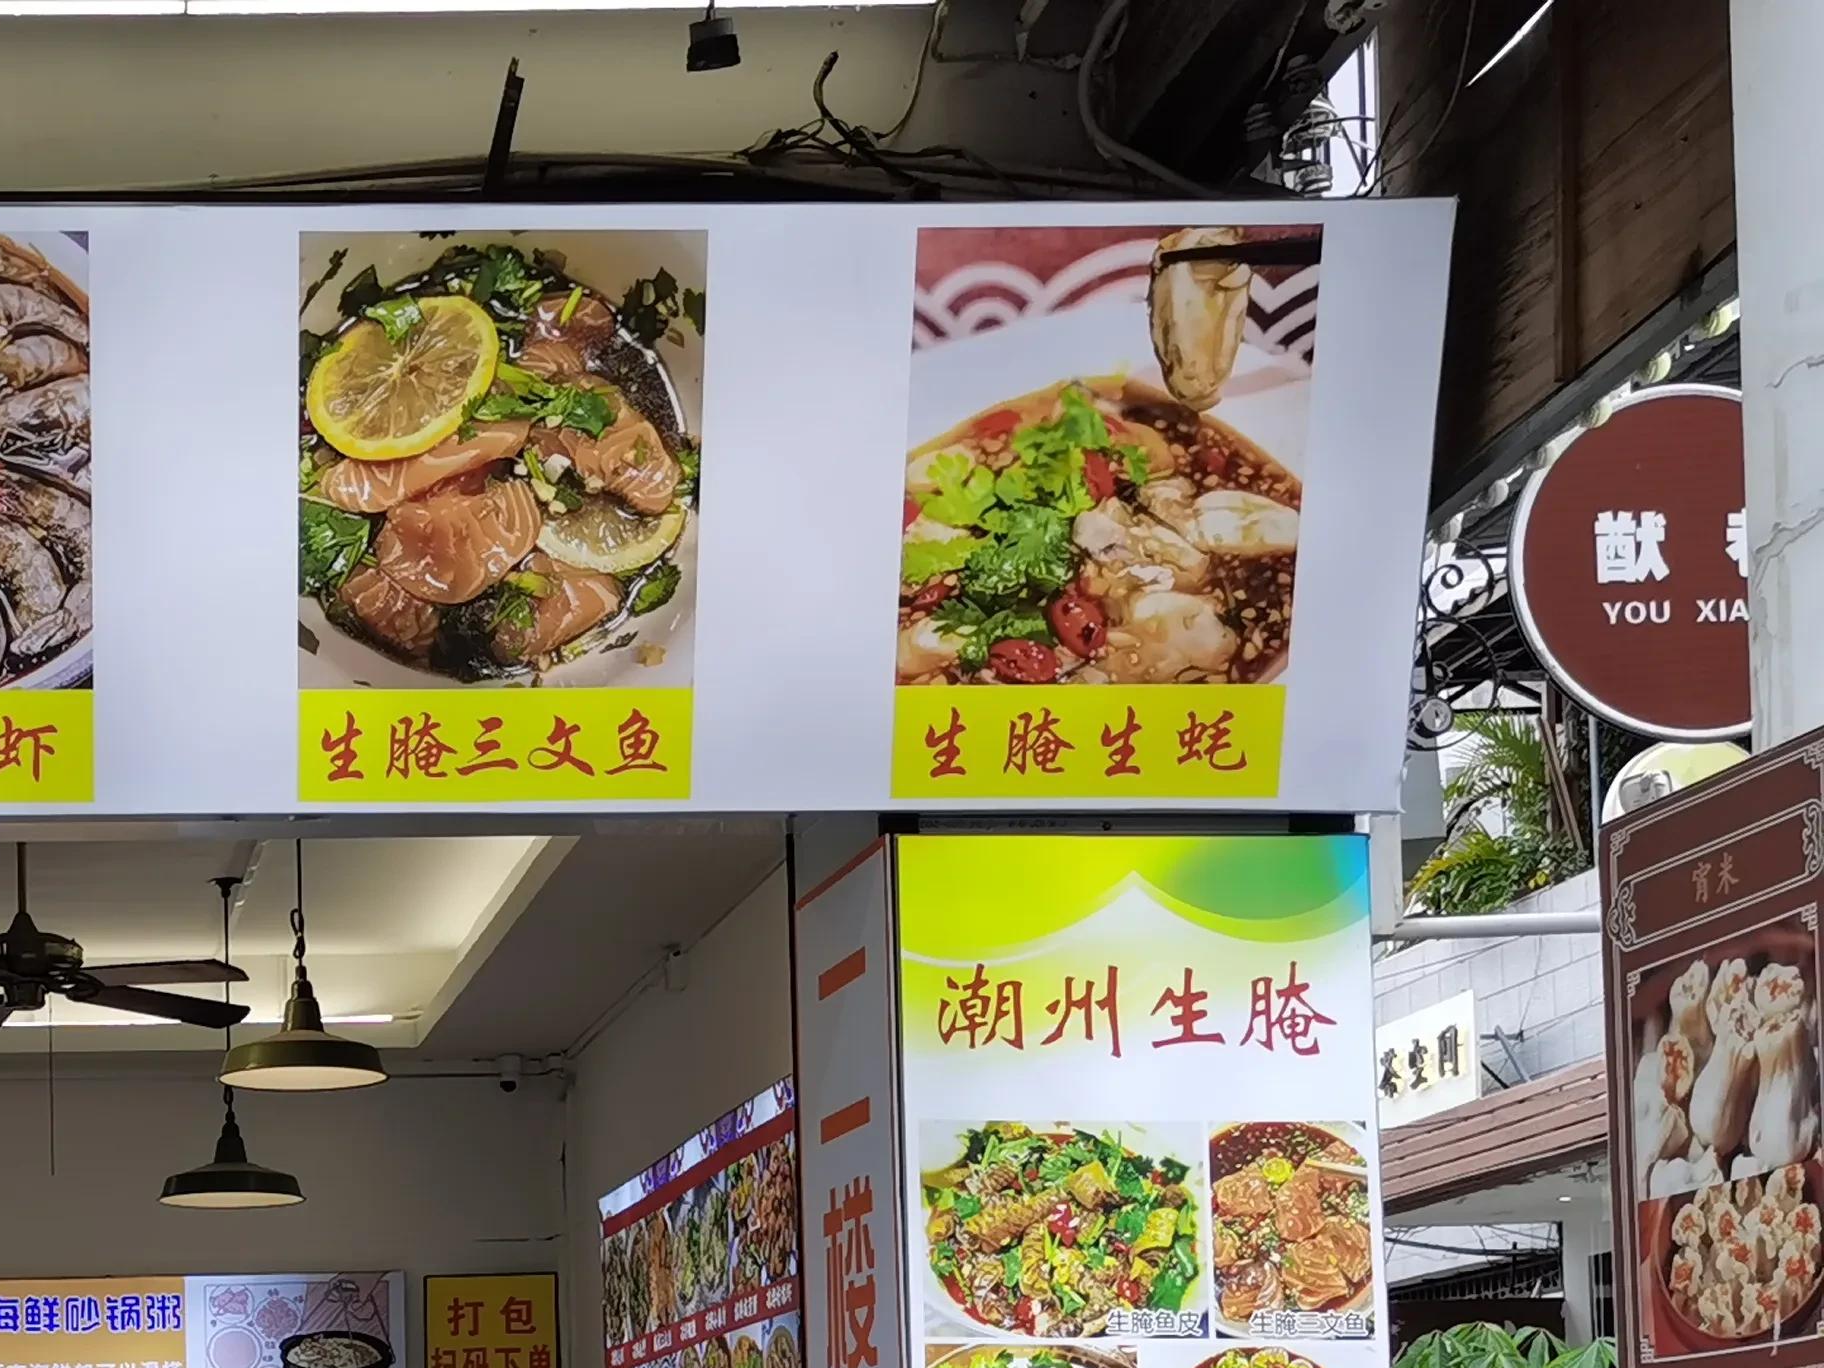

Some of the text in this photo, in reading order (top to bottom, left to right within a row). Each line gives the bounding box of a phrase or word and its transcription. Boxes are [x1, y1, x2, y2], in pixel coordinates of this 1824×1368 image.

[1603, 600, 1671, 624] YOU
[319, 708, 668, 783] 生腌三文鱼
[923, 706, 1250, 780] 生腌生蚝
[937, 961, 1338, 1058] 潮州生腌
[447, 1296, 537, 1337] 打包
[1107, 1311, 1203, 1337] 生腌鱼皮
[1251, 1311, 1367, 1337] 生腌三文鱼
